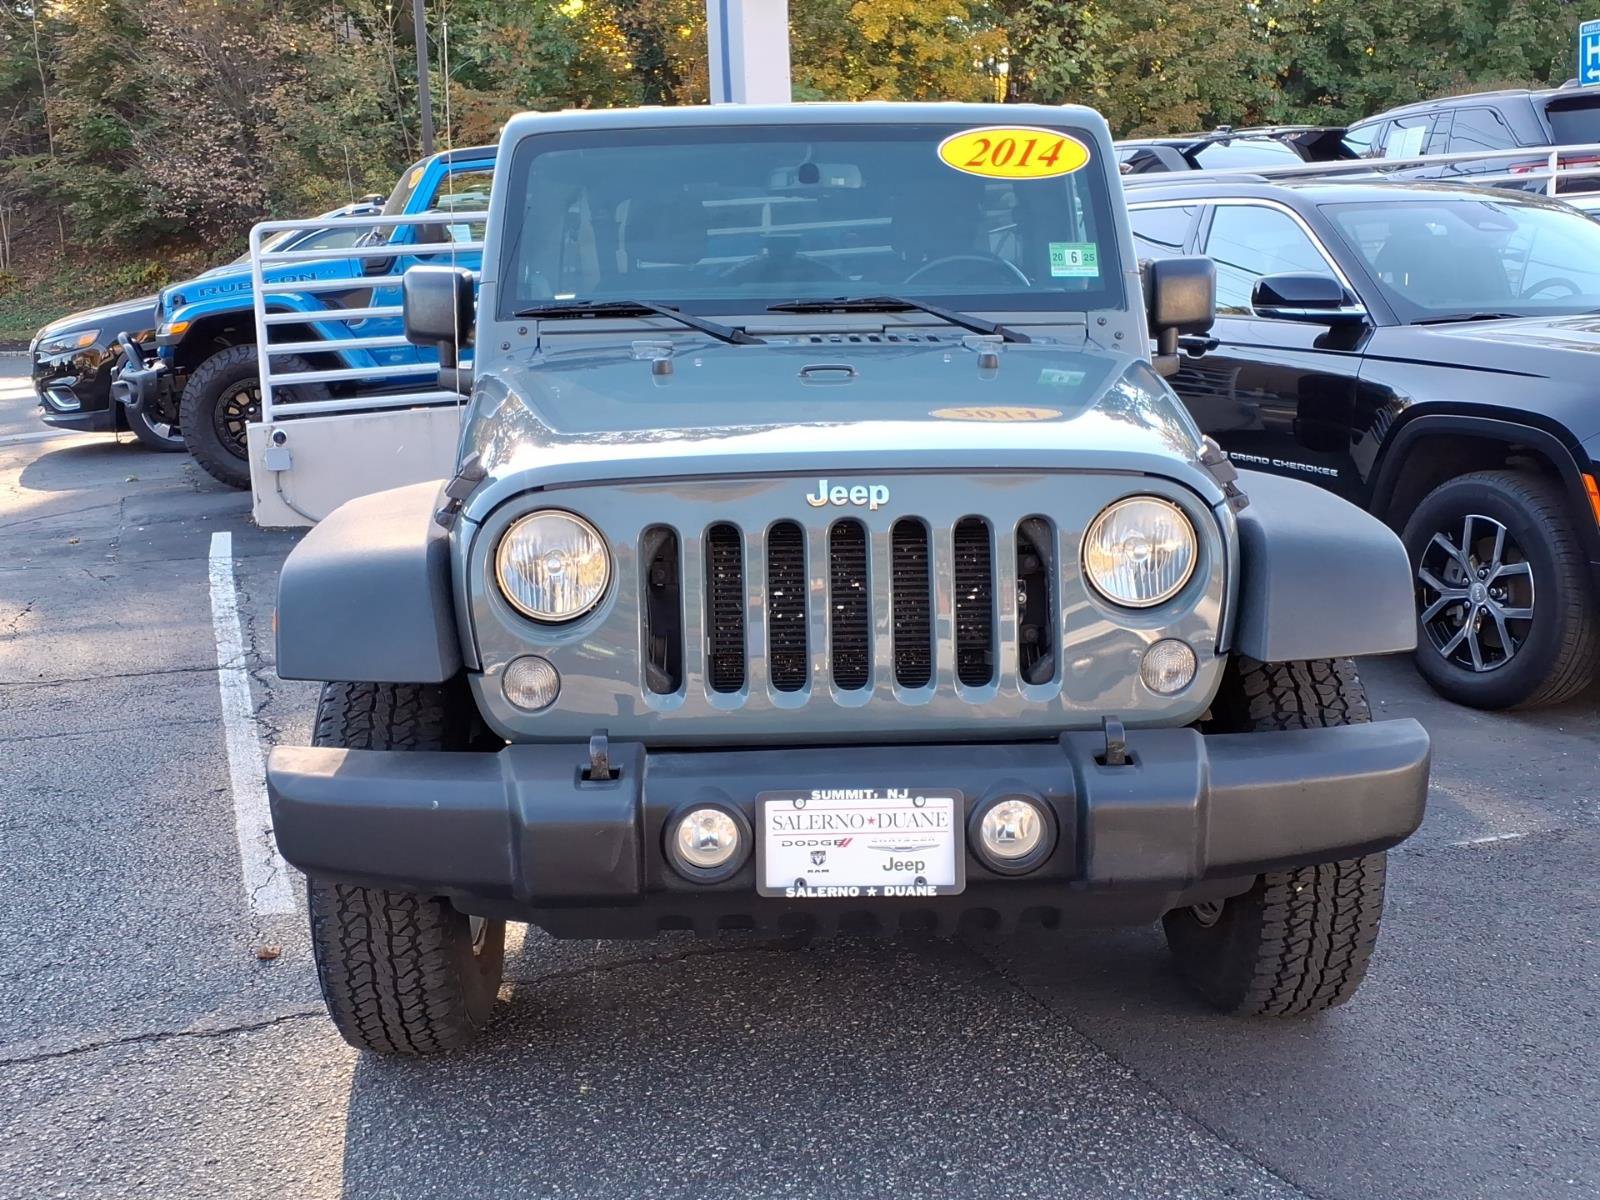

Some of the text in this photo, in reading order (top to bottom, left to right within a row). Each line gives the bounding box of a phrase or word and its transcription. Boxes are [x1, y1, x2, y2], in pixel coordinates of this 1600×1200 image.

[964, 137, 1066, 168] 2014
[1052, 251, 1095, 264] 20 6 25
[199, 272, 317, 297] RUBCON
[1230, 452, 1270, 465] GRAND
[1272, 459, 1339, 477] CHEROKEE
[806, 479, 889, 511] Jeep
[811, 788, 909, 801] SUMMIT, NJ
[772, 811, 949, 831] SALERNO DUANE
[781, 839, 843, 848] DODGE
[882, 857, 926, 873] Jeep
[785, 885, 937, 898] SALERNO DUANE
